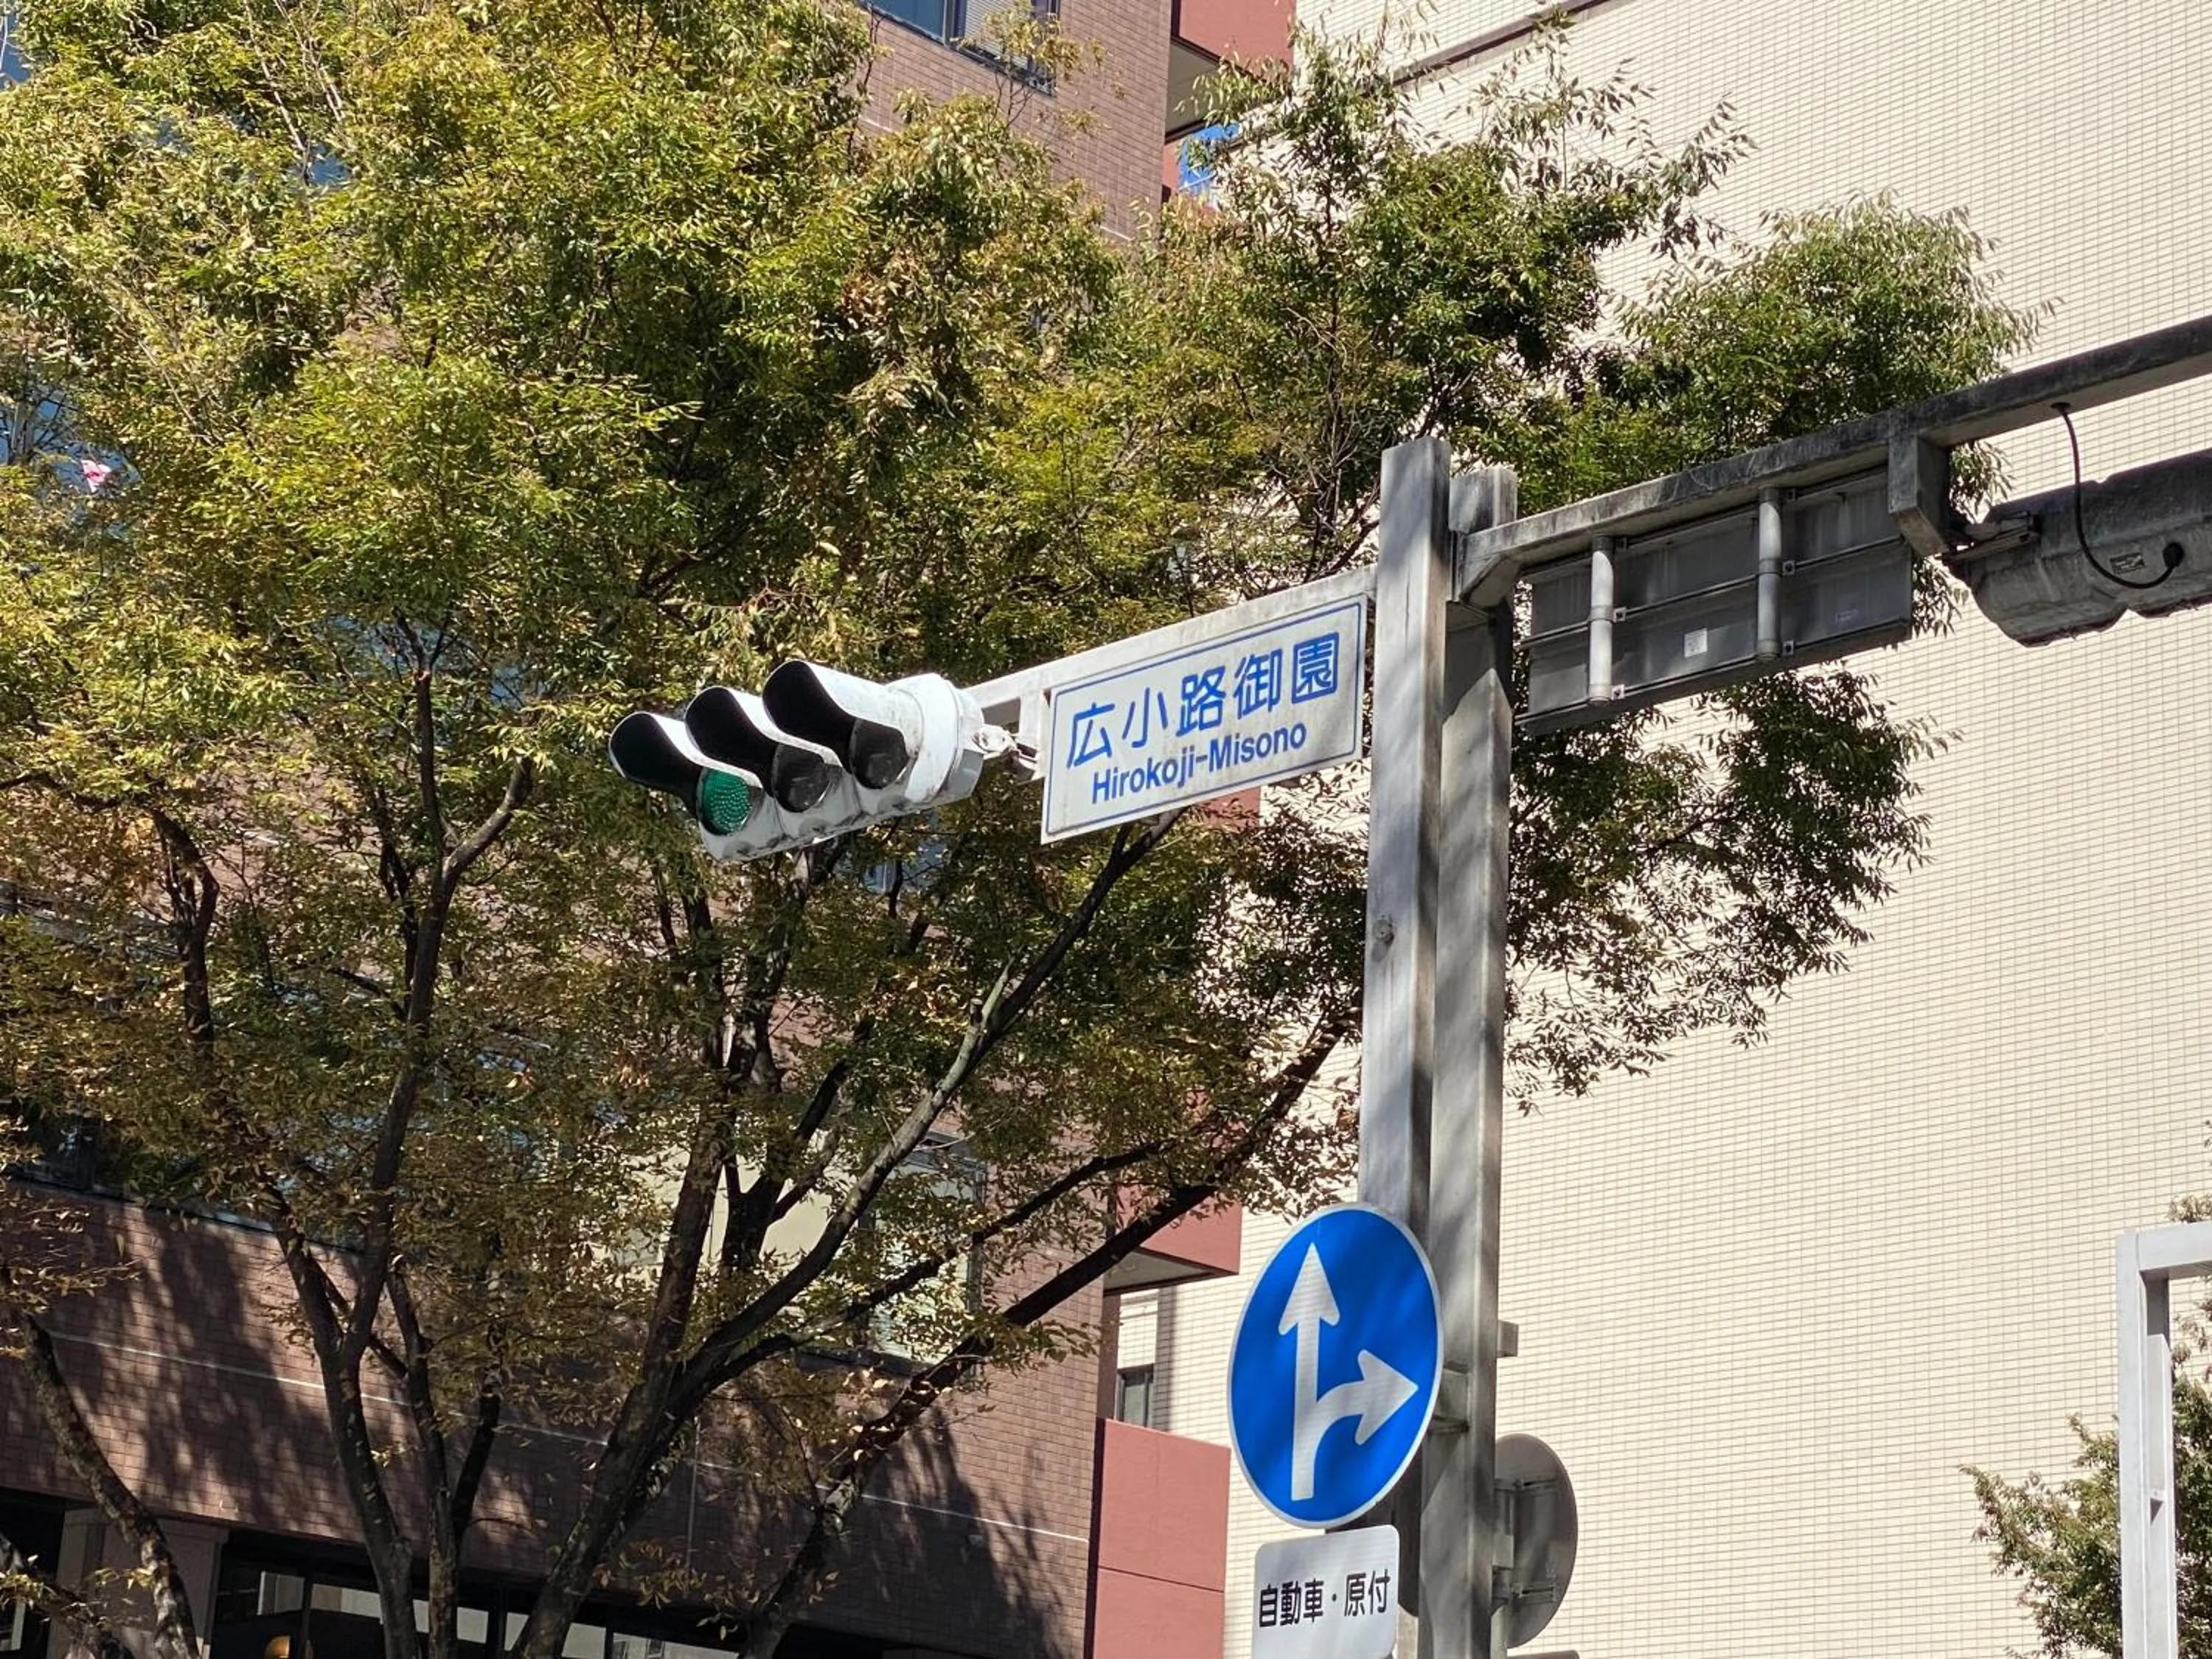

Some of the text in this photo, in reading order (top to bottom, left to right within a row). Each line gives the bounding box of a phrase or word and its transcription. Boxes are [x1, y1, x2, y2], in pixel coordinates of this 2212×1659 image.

[1067, 632, 1340, 769] 広小路御園
[1092, 723, 1307, 804] Hirokoji-Misono
[1259, 1569, 1391, 1627] 自動車・原付
